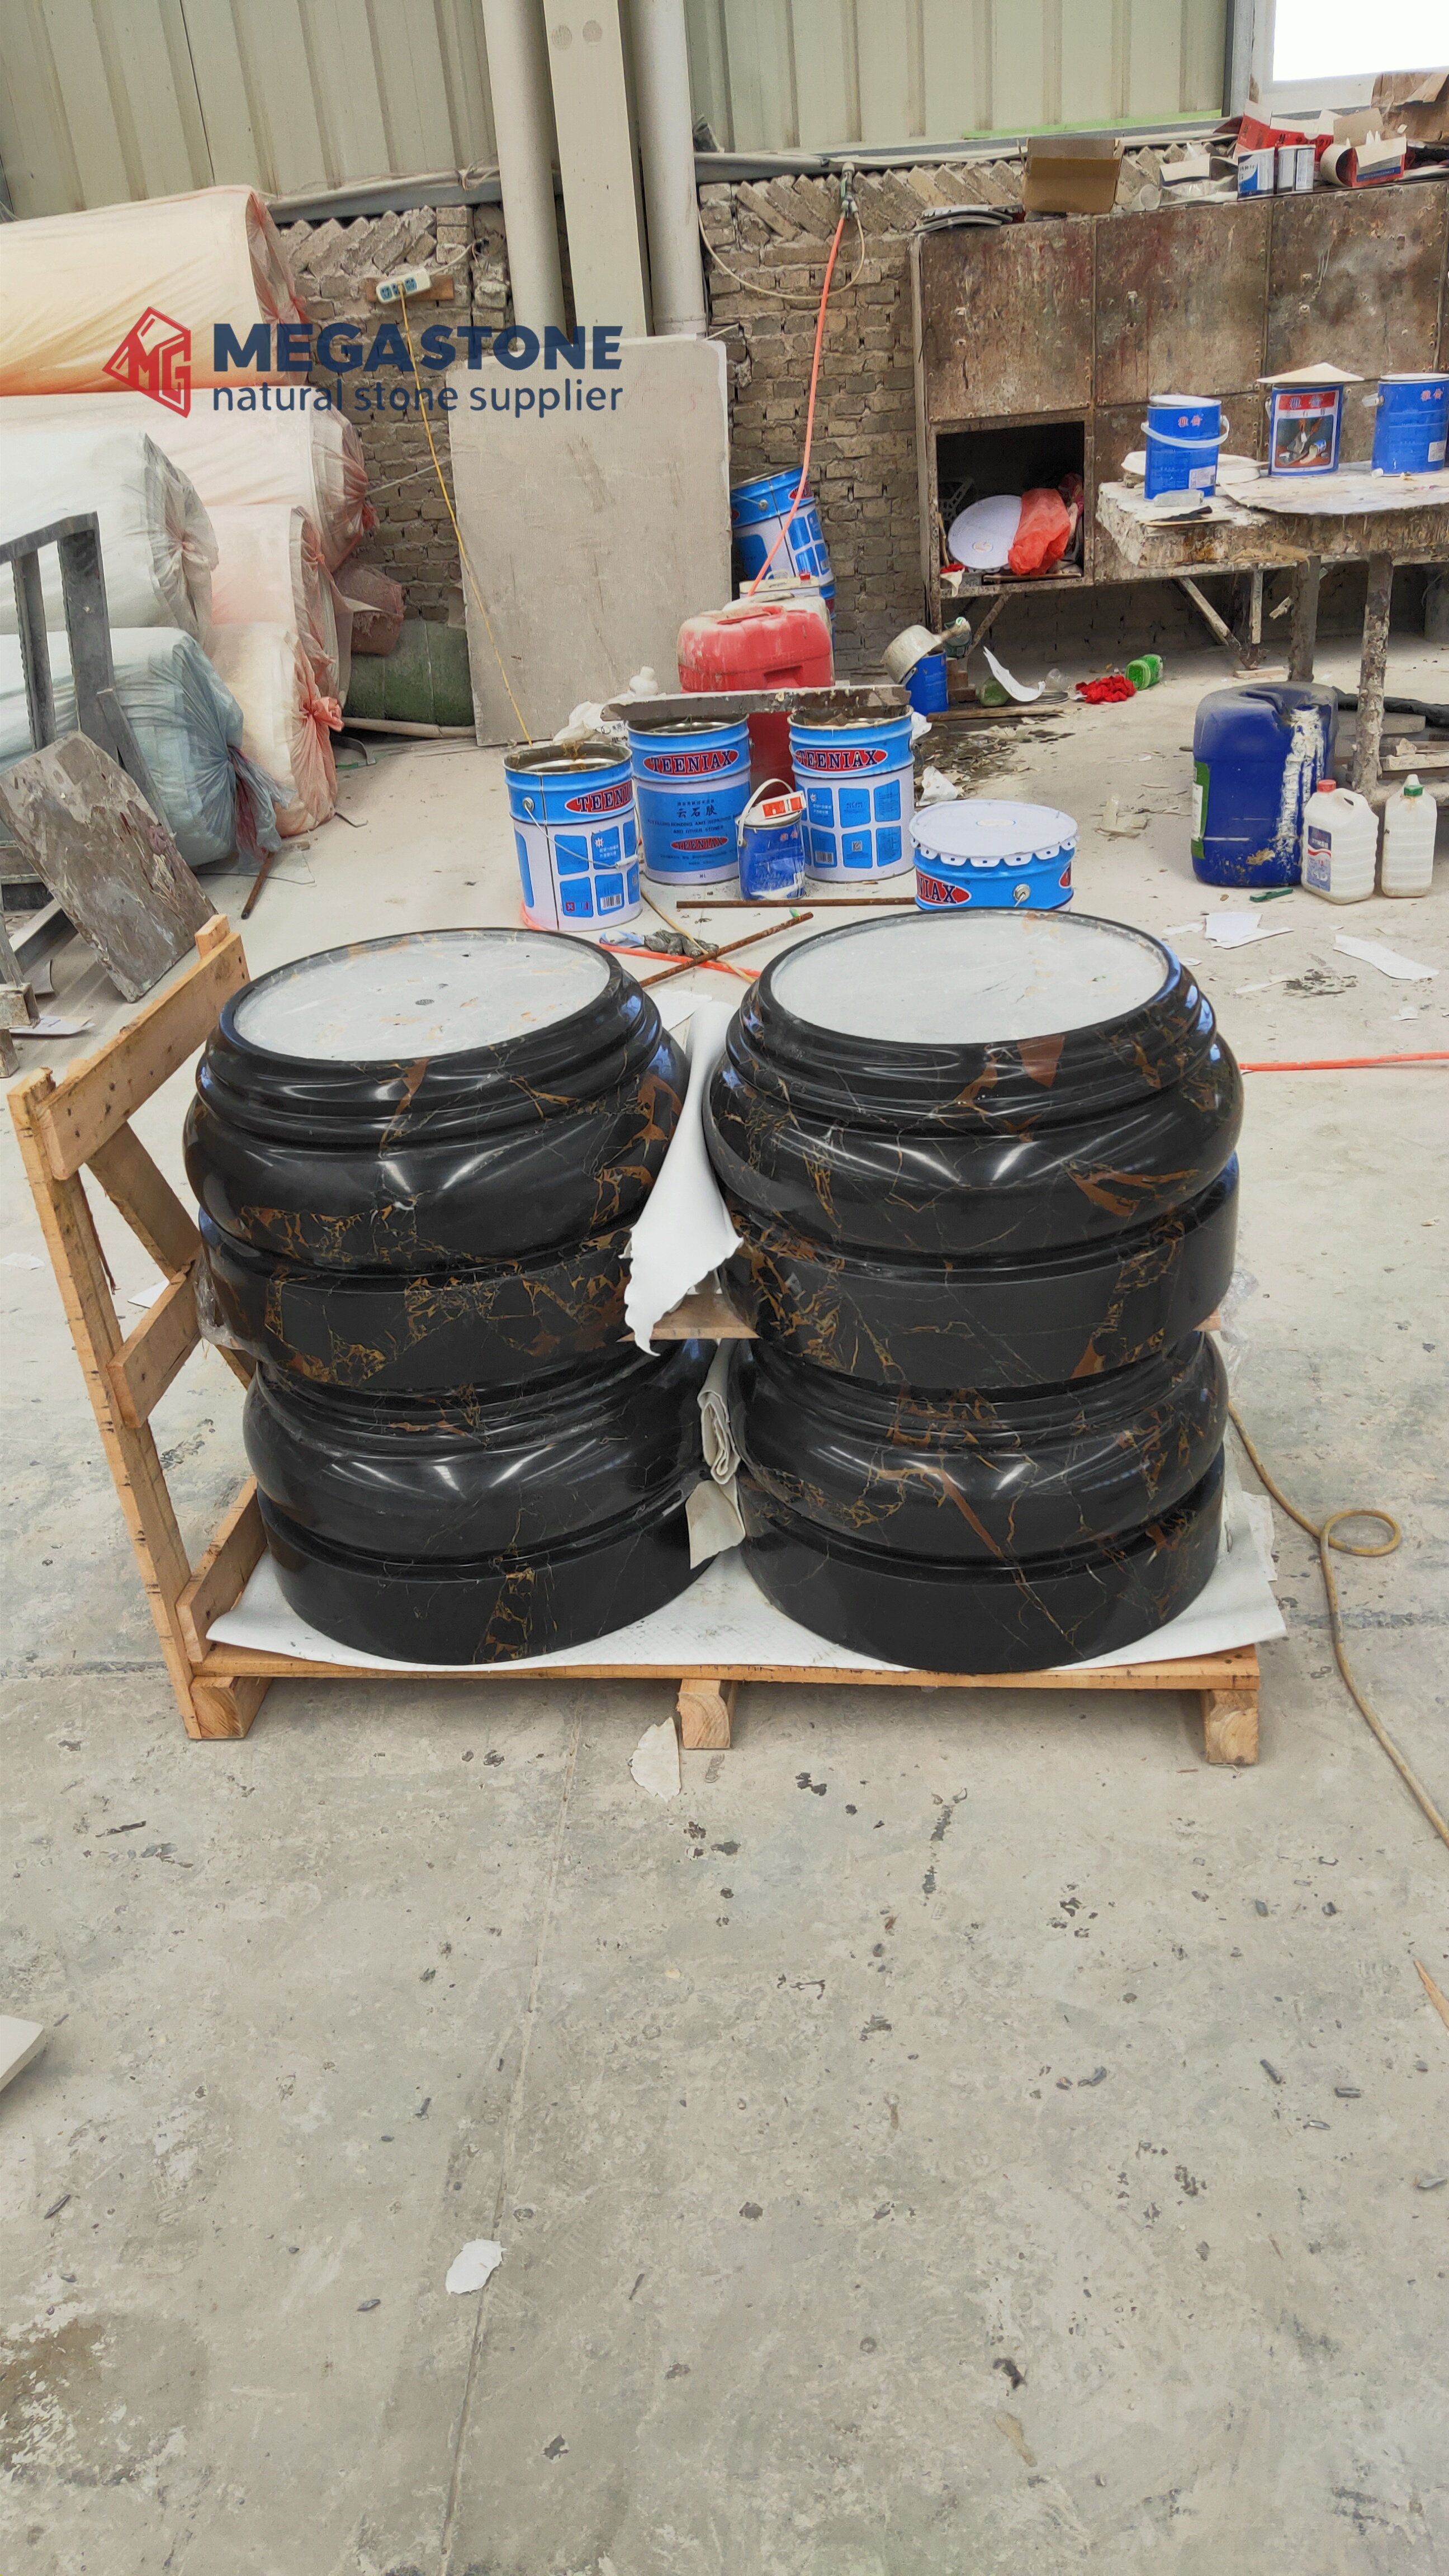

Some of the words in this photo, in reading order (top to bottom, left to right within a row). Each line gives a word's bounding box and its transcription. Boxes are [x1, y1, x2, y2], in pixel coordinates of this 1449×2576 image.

[651, 750, 732, 773] TEENIAX
[798, 749, 878, 769] TEENIAX
[577, 782, 632, 812] TEENI
[676, 804, 717, 818] 云石胶
[676, 837, 724, 850] TEENIAX
